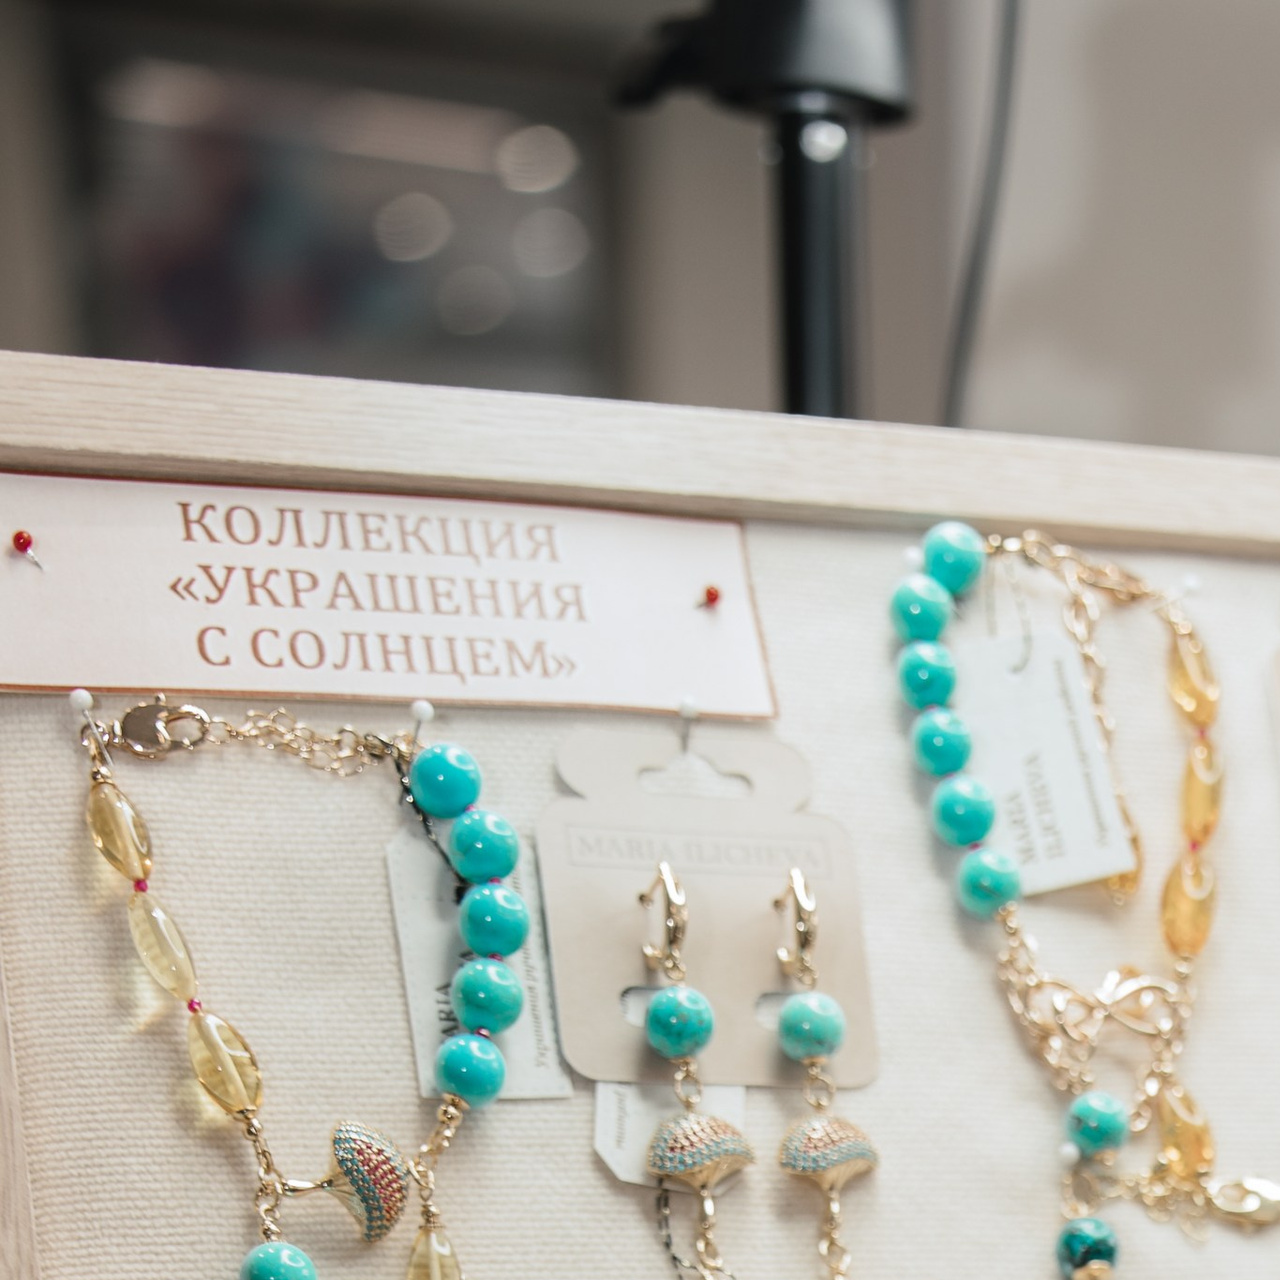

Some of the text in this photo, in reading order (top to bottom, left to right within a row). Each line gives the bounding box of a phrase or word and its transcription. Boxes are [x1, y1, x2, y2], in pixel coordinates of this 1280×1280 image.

[176, 502, 562, 566] КОЛЛЕКЦИЯ
[168, 564, 589, 622] «УКРАШЕНИЯ
[196, 625, 578, 685] С СОЛНЦЕМ»
